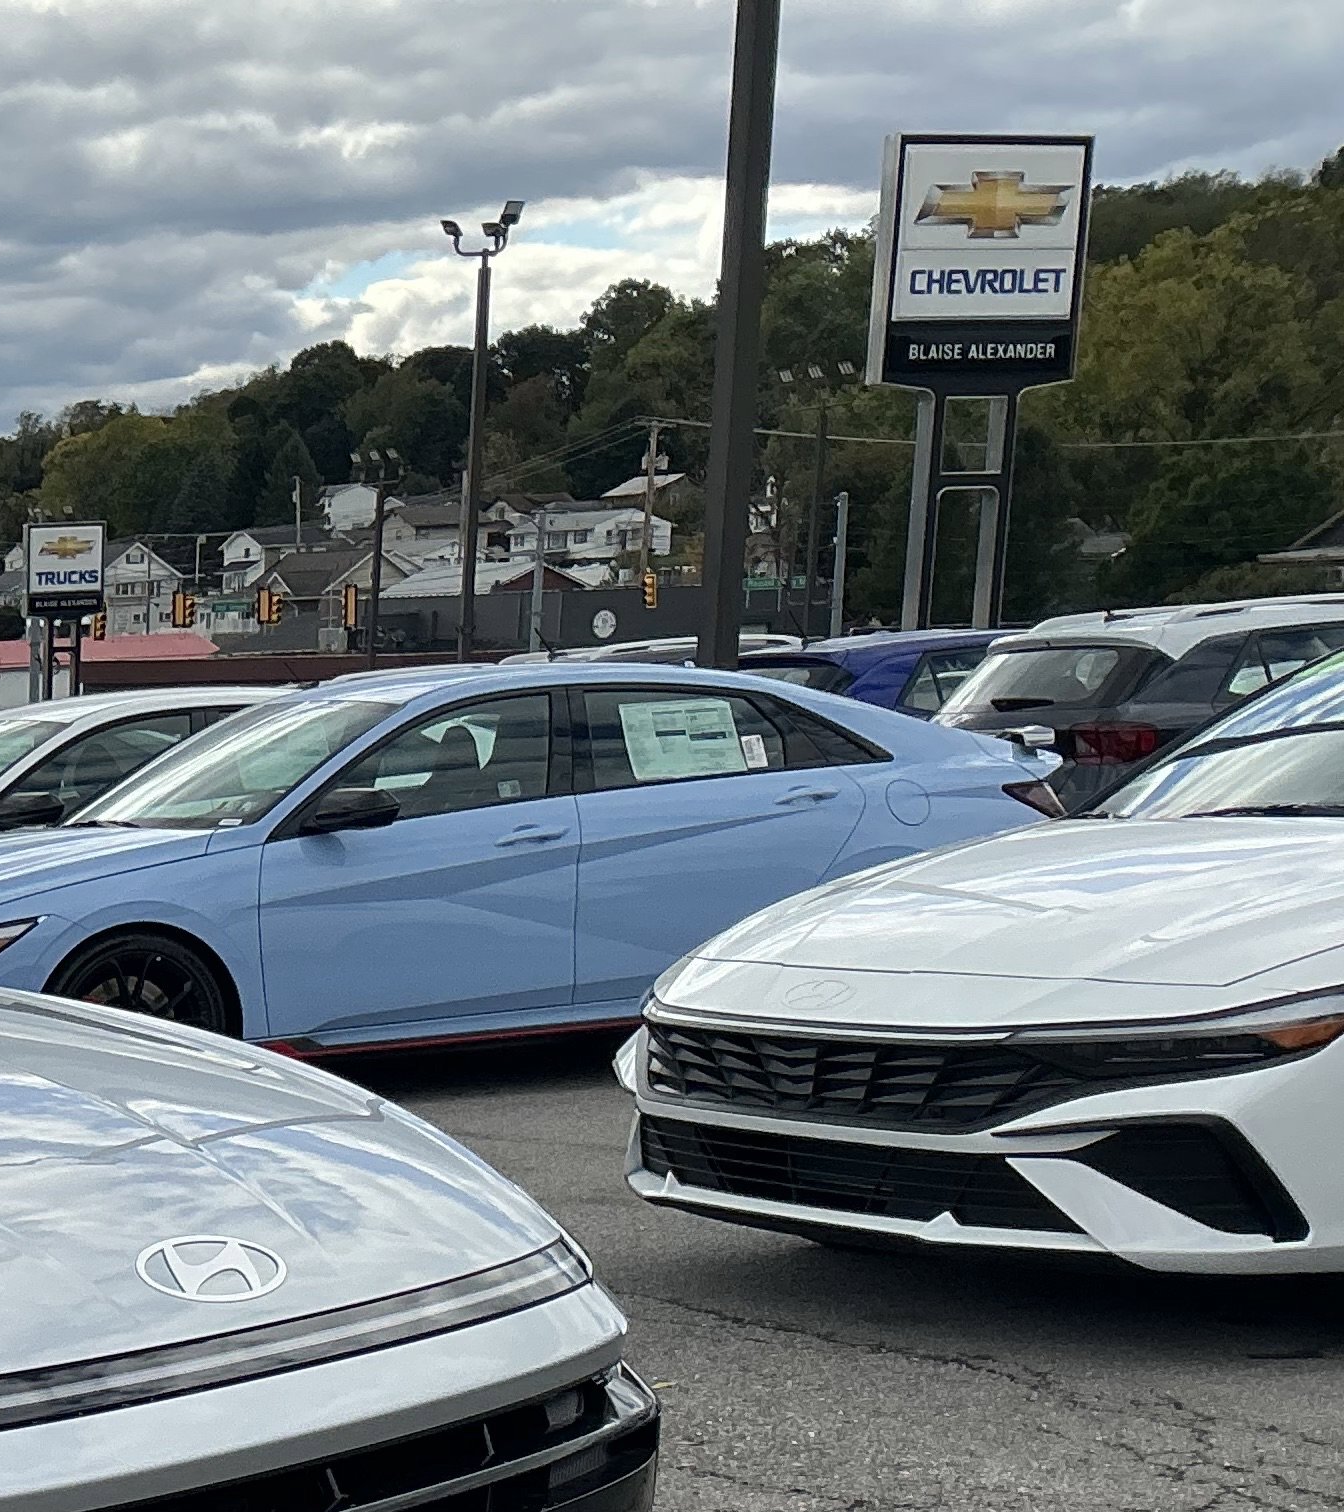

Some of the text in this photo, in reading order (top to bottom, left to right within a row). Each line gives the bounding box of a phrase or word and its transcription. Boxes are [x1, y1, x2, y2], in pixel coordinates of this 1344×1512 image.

[909, 268, 1067, 295] CHEVROLET
[908, 342, 1056, 361] BLAISE ALEXANDER
[35, 568, 99, 586] TRUCKS
